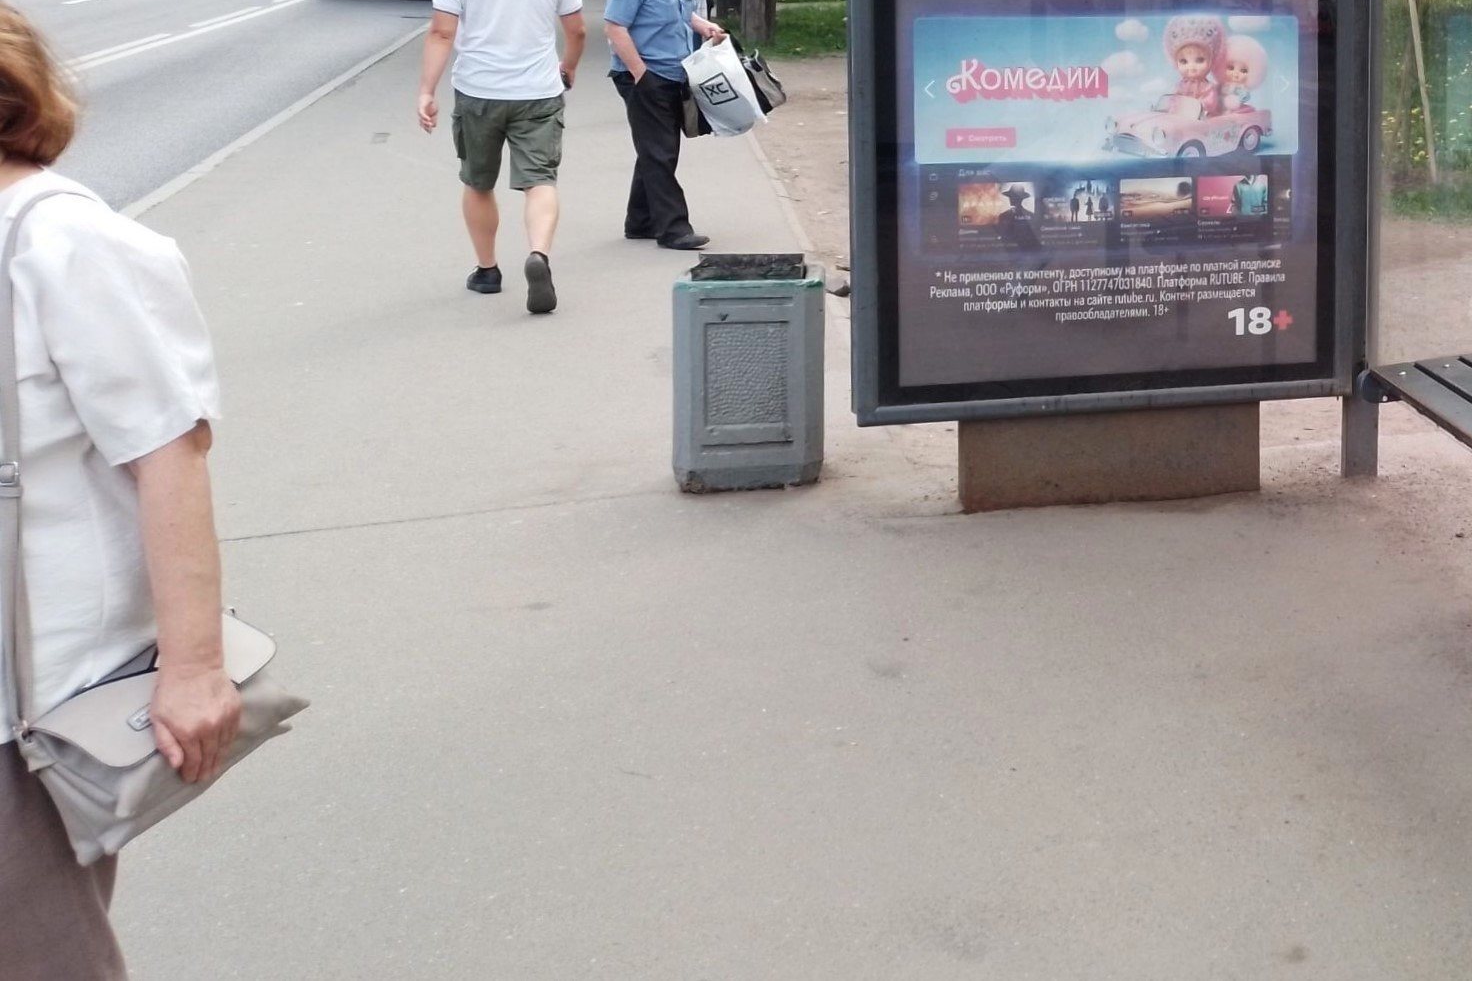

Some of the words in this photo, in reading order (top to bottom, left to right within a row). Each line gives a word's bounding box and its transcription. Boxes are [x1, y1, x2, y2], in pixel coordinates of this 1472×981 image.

[946, 58, 1103, 97] Комедии
[930, 286, 973, 298] Реклама,
[975, 283, 997, 296] ООО
[1053, 279, 1078, 293] ОГРН
[1157, 275, 1208, 289] Платформа
[1248, 271, 1286, 286] Правила
[944, 270, 957, 283] Не
[959, 271, 1014, 285] применимо
[1015, 270, 1022, 279] к
[1023, 269, 1068, 280] контенту,
[1069, 266, 1123, 279] доступному
[1125, 266, 1136, 275] на
[1138, 261, 1188, 276] платформе
[1190, 263, 1201, 272] по
[1203, 259, 1239, 271] платной
[1240, 259, 1282, 270] подписке
[964, 298, 1018, 313] платформы
[1020, 300, 1027, 309] и
[1028, 298, 1072, 308] контакты
[1073, 297, 1085, 306] на
[1087, 294, 1113, 305] сайте
[1160, 290, 1196, 302] Контент
[1197, 288, 1256, 302] размещается
[1055, 307, 1151, 323] правообладателями.
[1153, 304, 1170, 317] 18+
[1228, 306, 1293, 335] 18+
